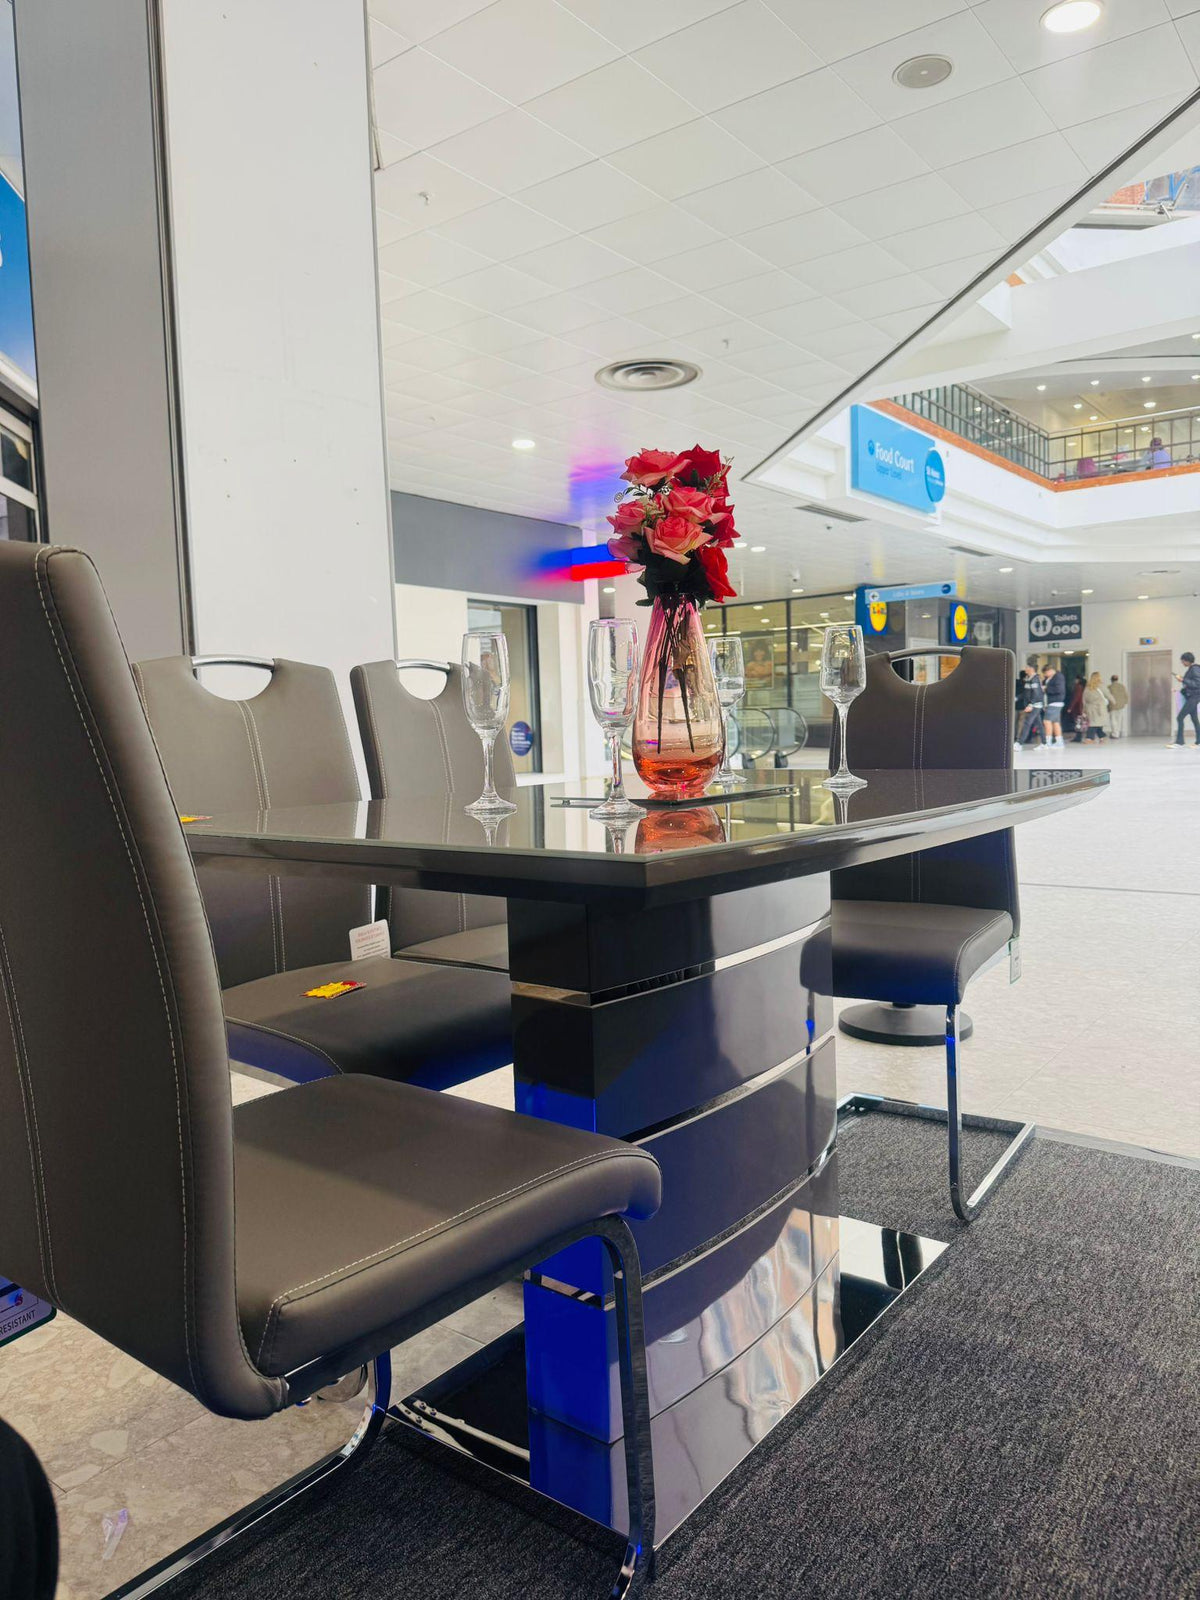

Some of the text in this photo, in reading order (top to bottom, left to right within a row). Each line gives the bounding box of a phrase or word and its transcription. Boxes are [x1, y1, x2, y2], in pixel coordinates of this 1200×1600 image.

[875, 442, 893, 464] Food
[894, 450, 914, 473] Court
[1054, 614, 1078, 622] Toilets
[0, 1310, 36, 1335] RESISTANT
